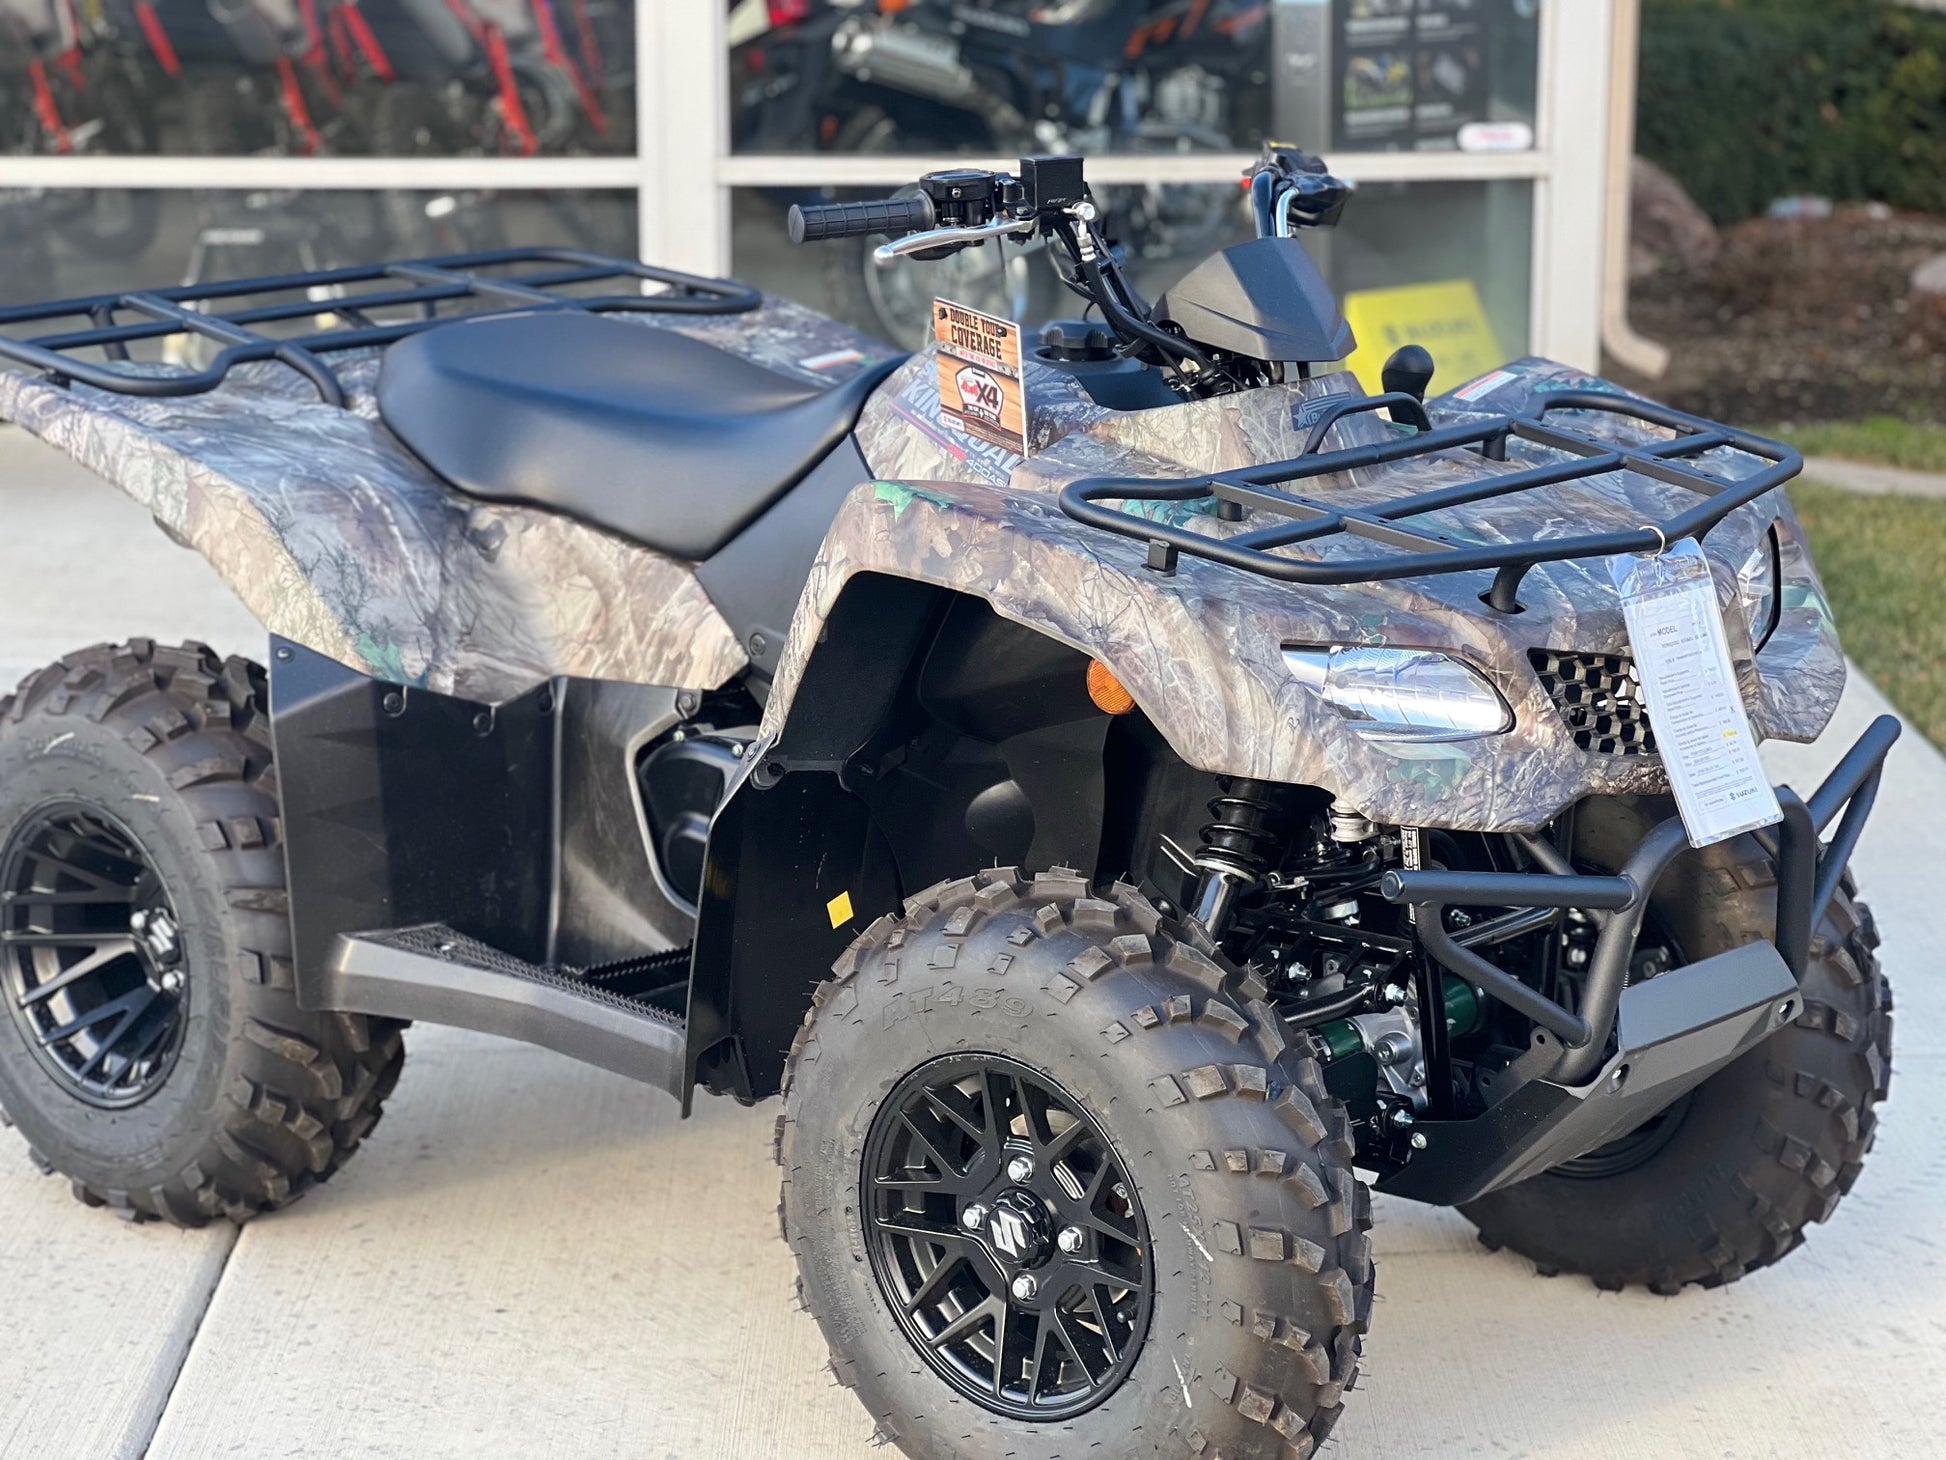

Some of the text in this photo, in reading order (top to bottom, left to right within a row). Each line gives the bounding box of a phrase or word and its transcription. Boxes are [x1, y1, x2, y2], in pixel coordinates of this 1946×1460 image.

[949, 307, 979, 330] DOUBLE
[951, 324, 1003, 361] COVERAGE
[1656, 625, 1678, 637] MODEL
[881, 985, 1035, 1032] AT489
